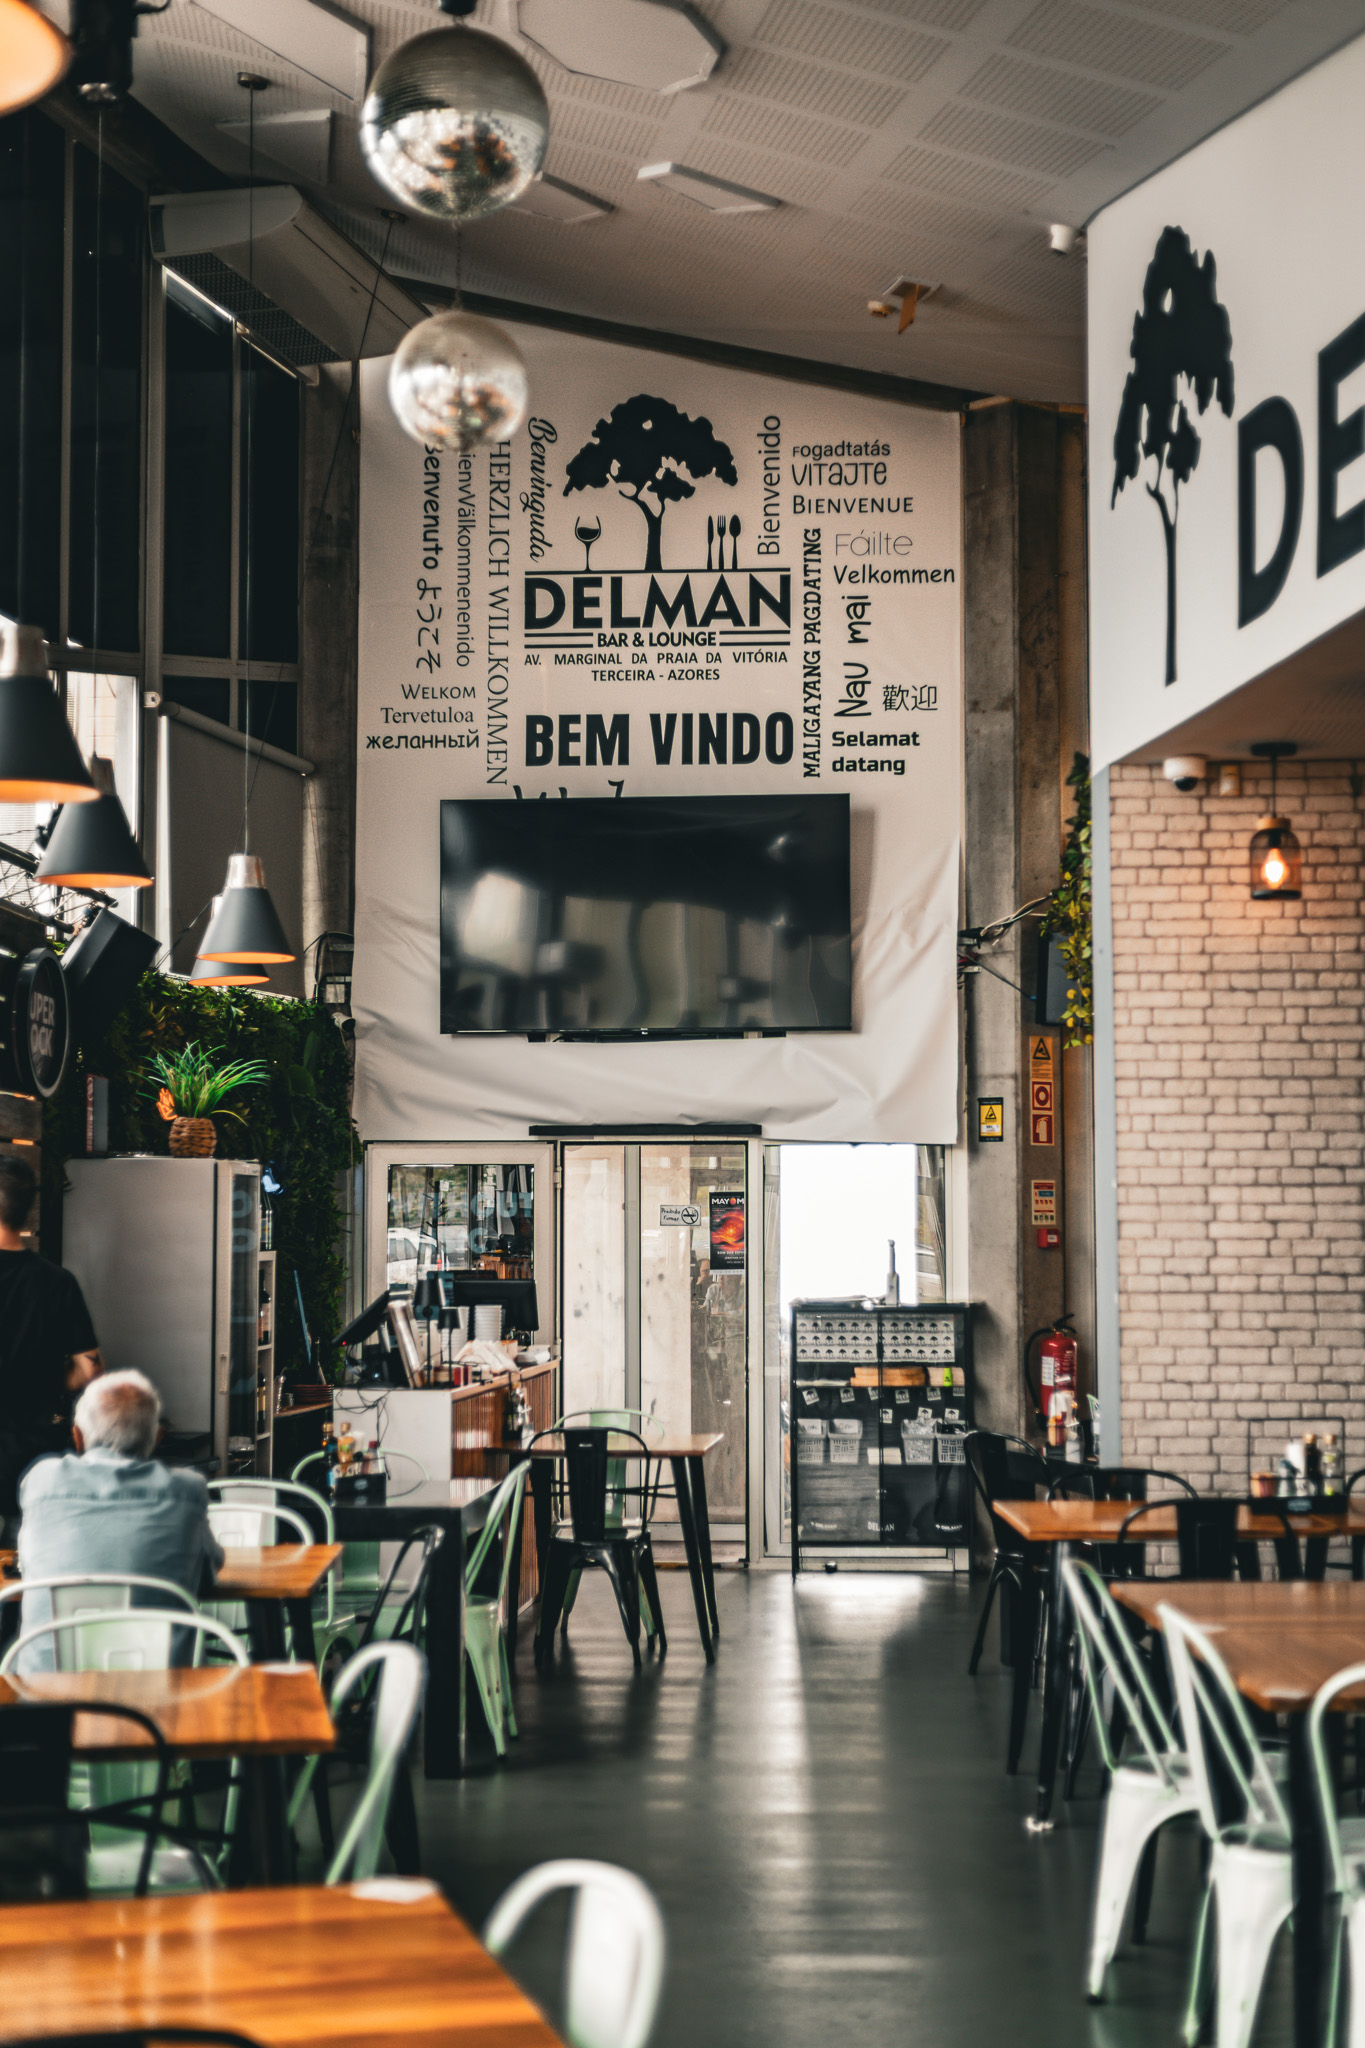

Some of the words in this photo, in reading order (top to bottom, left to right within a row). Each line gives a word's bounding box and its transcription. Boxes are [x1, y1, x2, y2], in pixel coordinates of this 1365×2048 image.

[793, 440, 891, 462] Fogadtatás
[520, 416, 558, 562] Benvinguda
[757, 414, 781, 554] Bienvenido
[488, 439, 511, 577] HERZLICH
[454, 448, 477, 668] ienvVälkommenenido
[836, 530, 913, 556] Fáilte
[803, 528, 821, 644] PAGDATING
[834, 564, 954, 584] Velkommen
[524, 574, 791, 629] DELMAN
[416, 578, 442, 673] ようこそ
[842, 595, 871, 643] mai
[598, 633, 628, 647] BAR
[632, 632, 644, 647] &
[649, 631, 716, 647] LOUNGE
[525, 654, 542, 666] AV.
[555, 653, 622, 665] MARGINAL
[632, 653, 647, 664] DA
[658, 653, 698, 663] PRAIA
[706, 652, 722, 663] DA
[733, 649, 787, 663] VITÓRIA
[487, 586, 509, 785] WILLKOMMEN
[592, 670, 655, 681] TERCEIRA
[668, 669, 719, 680] AZORES
[834, 662, 871, 717] Nau
[803, 651, 821, 777] MALIGAYANG
[883, 685, 937, 711] 歡迎
[381, 707, 473, 723] Tervetuloa
[366, 729, 479, 749] желанный
[526, 714, 629, 766] BEM
[650, 712, 793, 765] VINDO
[832, 731, 920, 746] Selamat
[832, 757, 905, 775] datang
[29, 992, 55, 1026] UPER
[29, 1024, 54, 1057] OCK
[867, 1521, 895, 1532] DELAN
